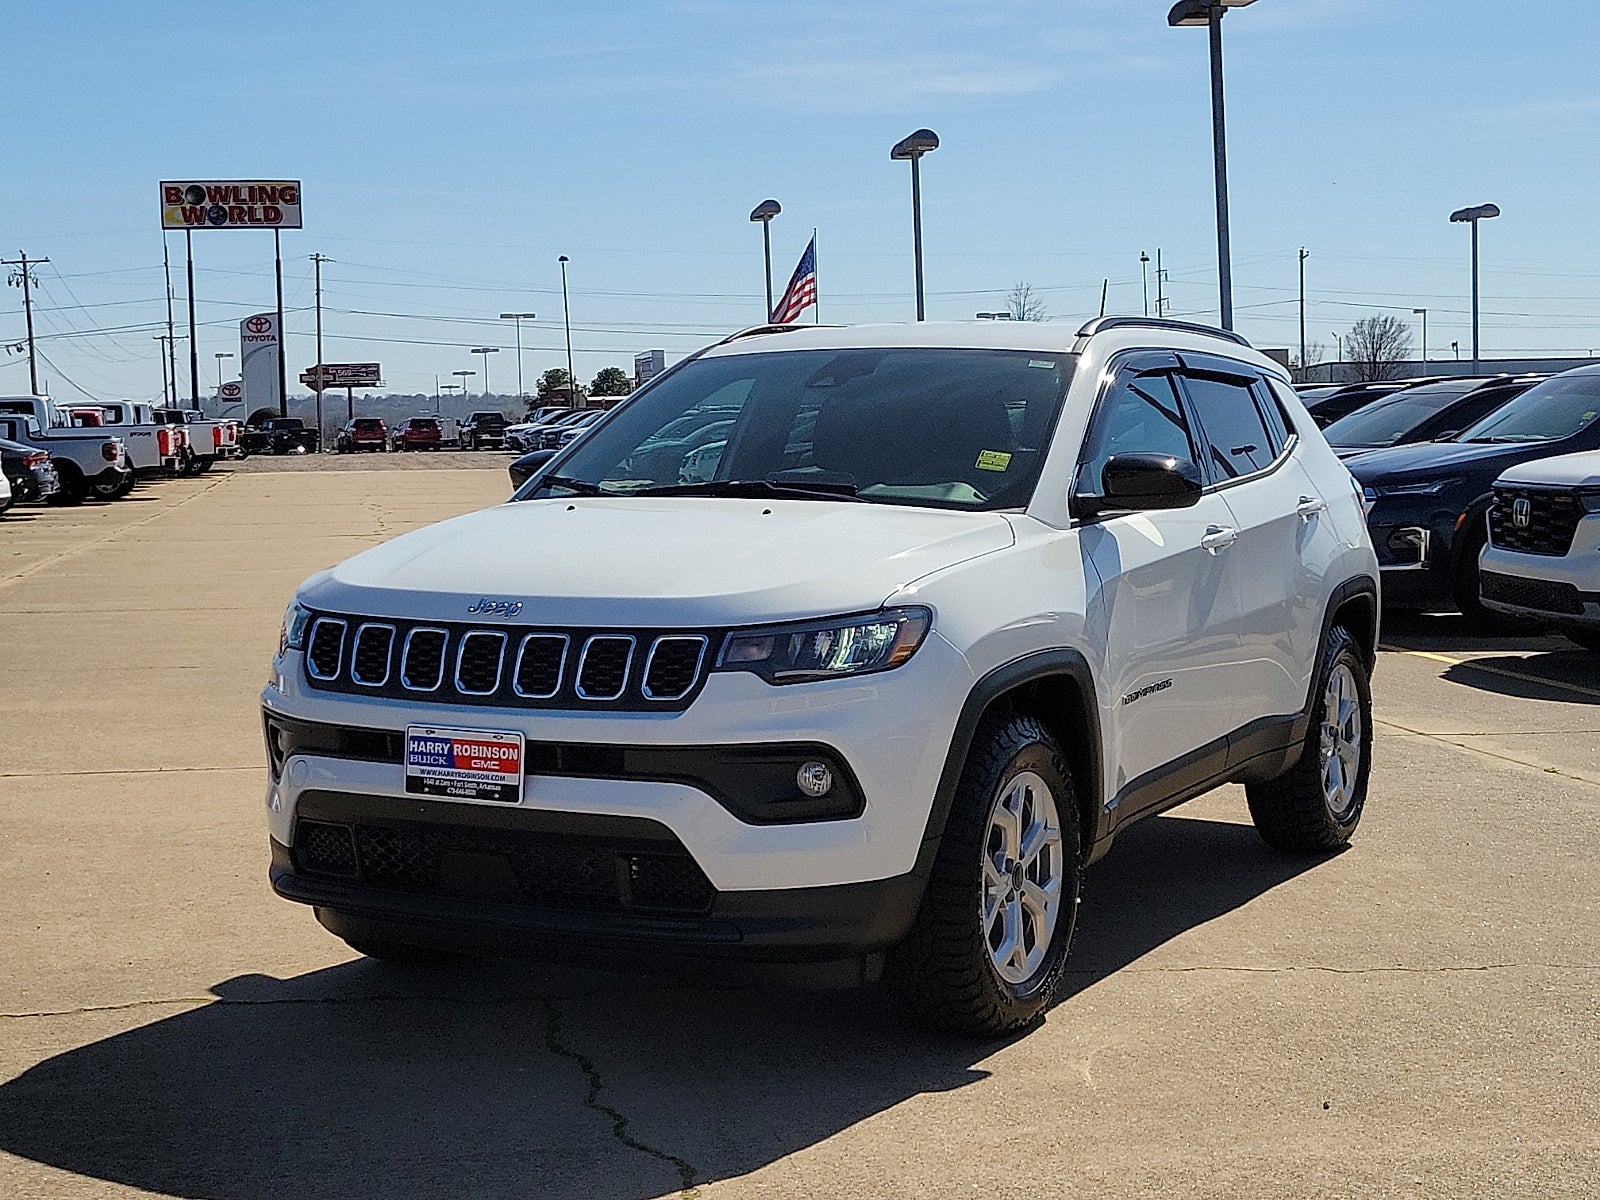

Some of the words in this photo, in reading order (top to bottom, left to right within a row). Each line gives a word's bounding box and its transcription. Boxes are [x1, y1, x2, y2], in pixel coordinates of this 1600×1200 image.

[164, 185, 298, 205] BOWLING
[180, 205, 283, 225] WORLD
[242, 334, 277, 342] TOYOTA
[468, 596, 523, 620] Jeep
[409, 741, 450, 755] HARRY
[453, 744, 518, 760] ROBINSON
[409, 754, 449, 765] BUICK
[471, 759, 500, 770] GMC
[420, 768, 506, 782] WWW.HARRYROBINSON.COM
